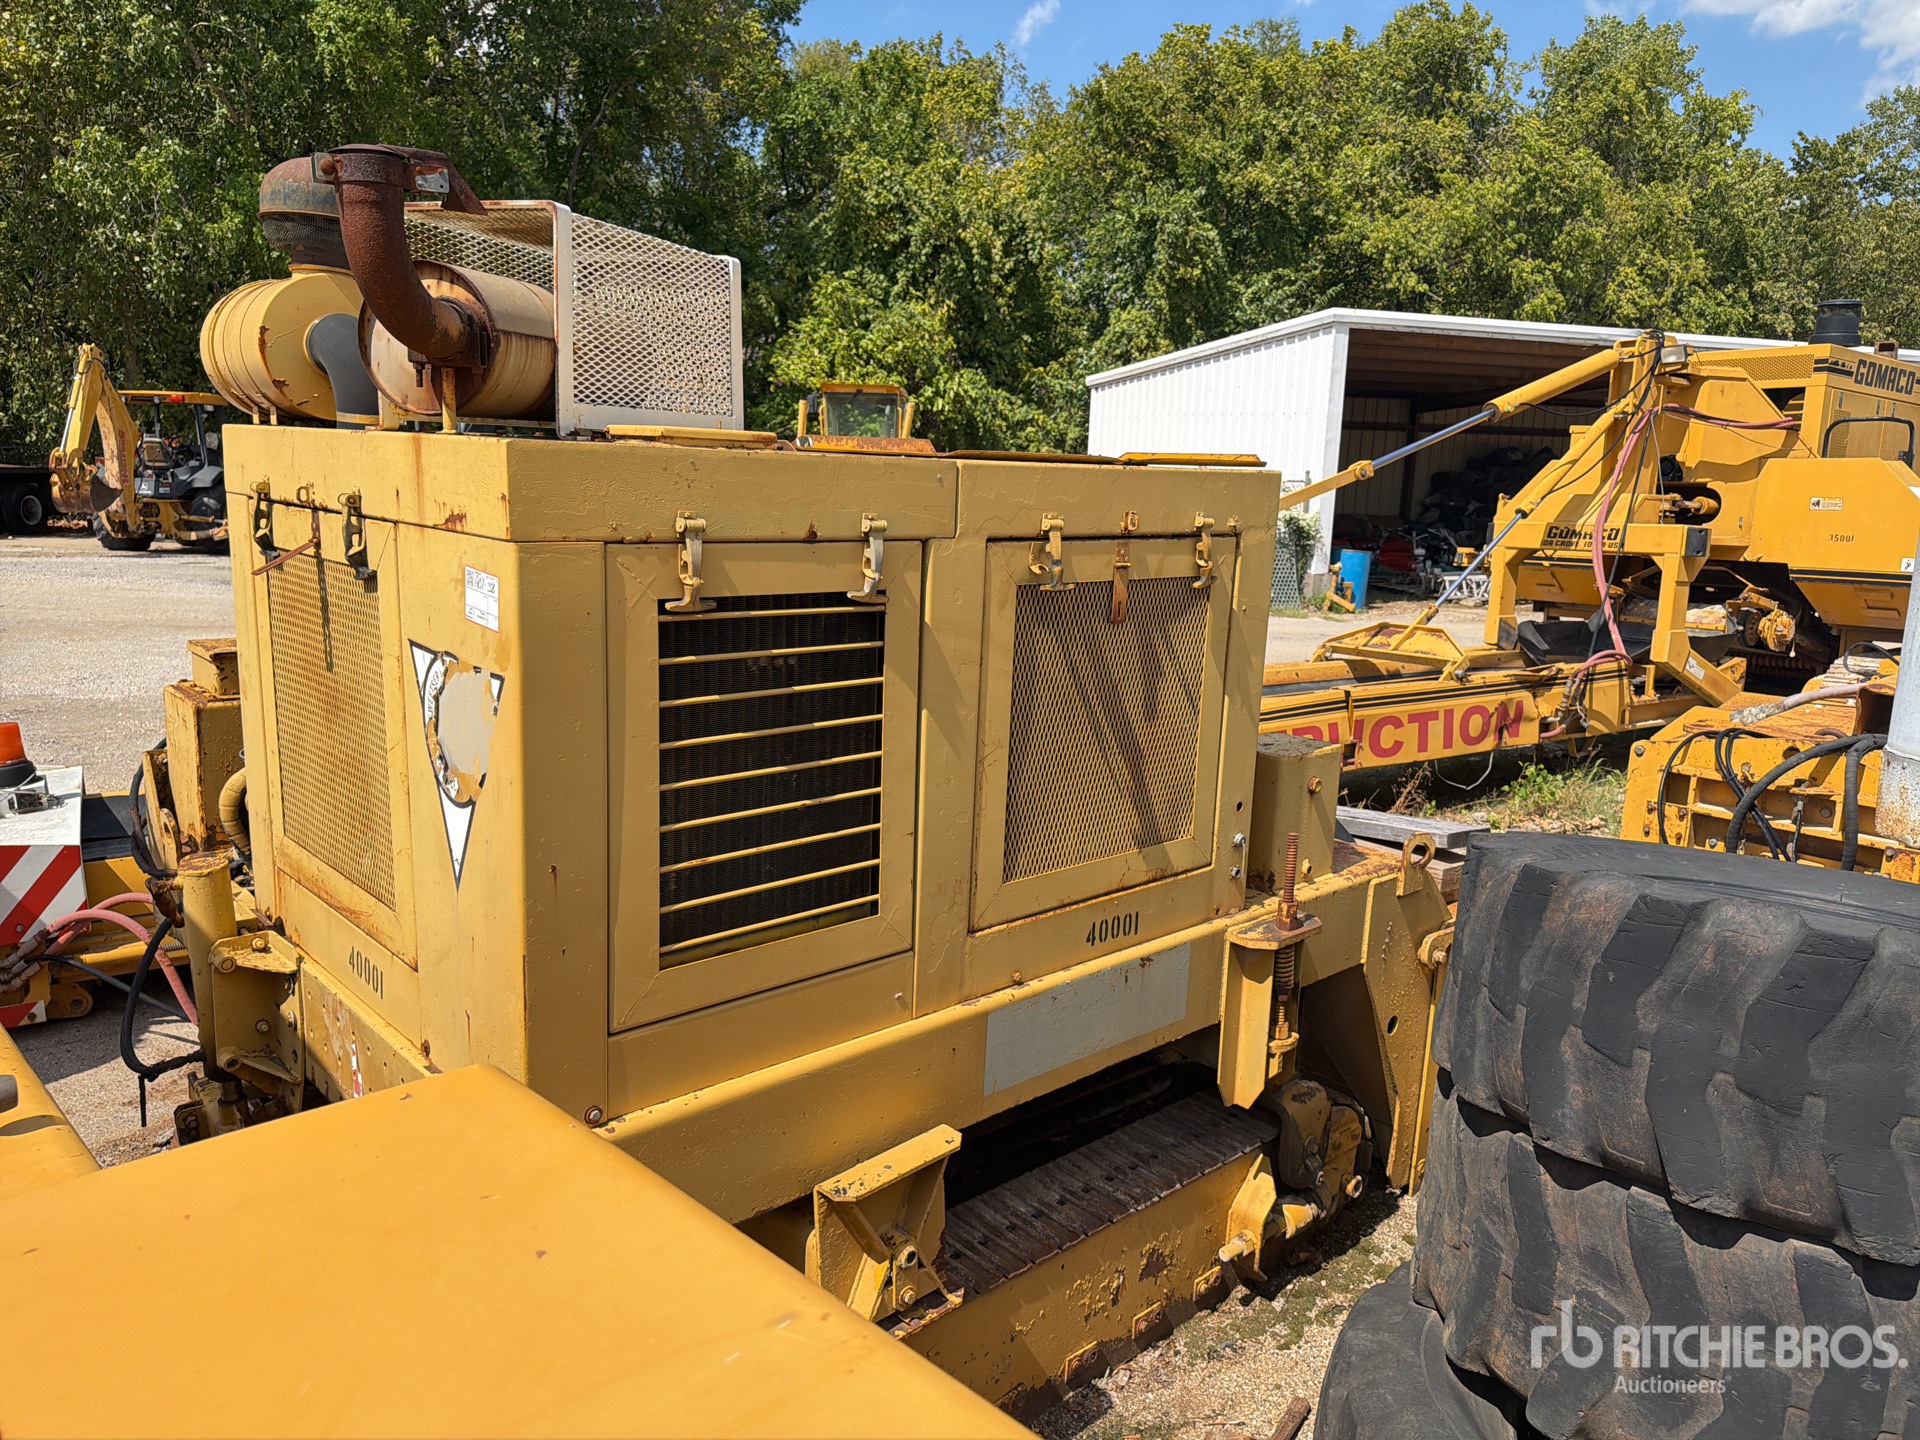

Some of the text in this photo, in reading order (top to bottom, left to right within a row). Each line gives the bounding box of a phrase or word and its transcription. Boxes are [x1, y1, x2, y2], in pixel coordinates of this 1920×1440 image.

[1854, 358, 1916, 395] GOMACO
[1828, 534, 1854, 543] 35001
[1086, 911, 1139, 947] 40001
[348, 945, 384, 1000] 40001
